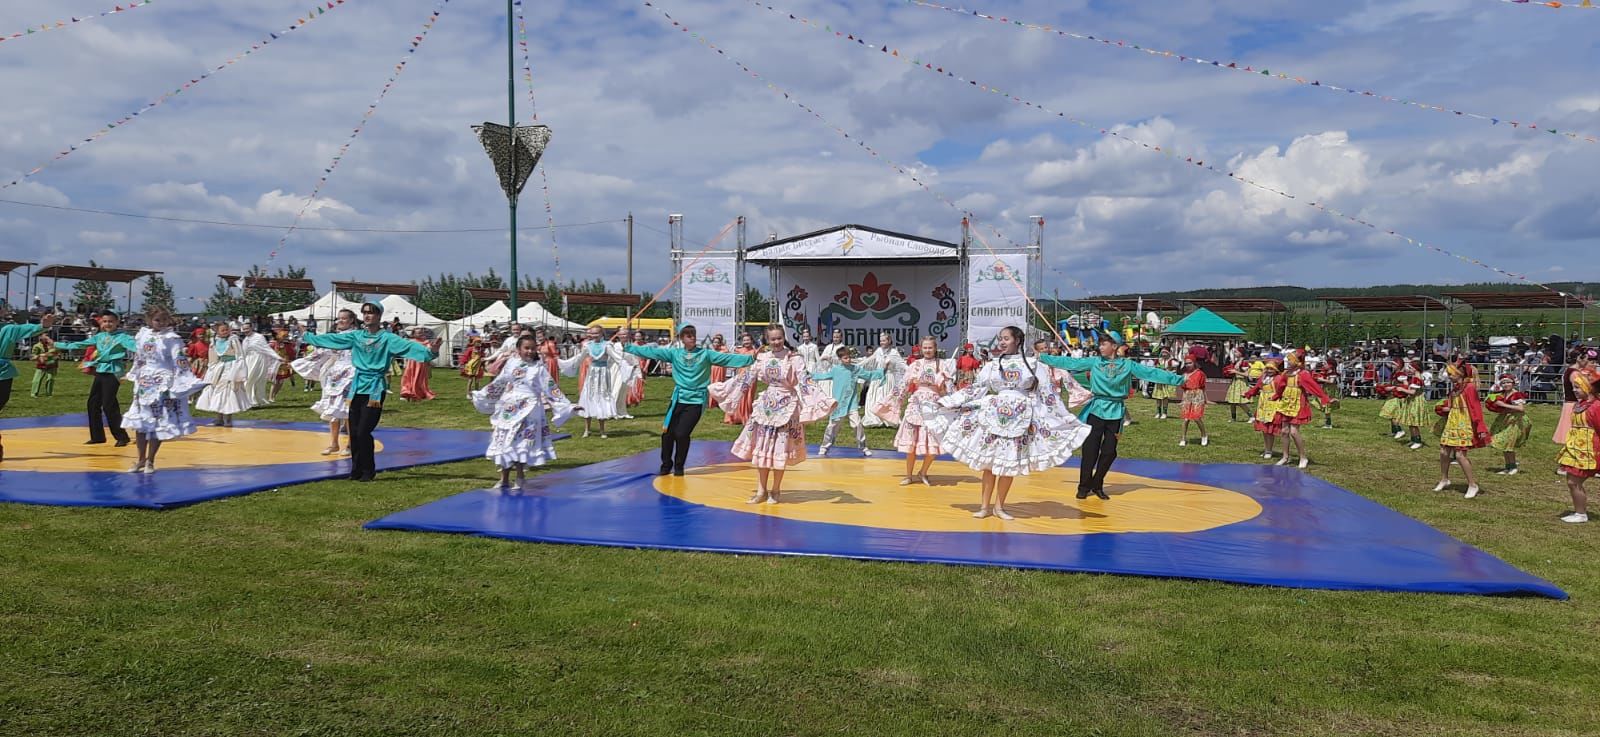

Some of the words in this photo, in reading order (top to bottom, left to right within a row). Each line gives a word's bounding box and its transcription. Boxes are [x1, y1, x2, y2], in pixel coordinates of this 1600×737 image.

[870, 233, 904, 247] Рыбная
[907, 241, 944, 255] Слобода
[684, 307, 732, 317] САБАНТУЙ
[971, 306, 1023, 317] САБАНТУЙ
